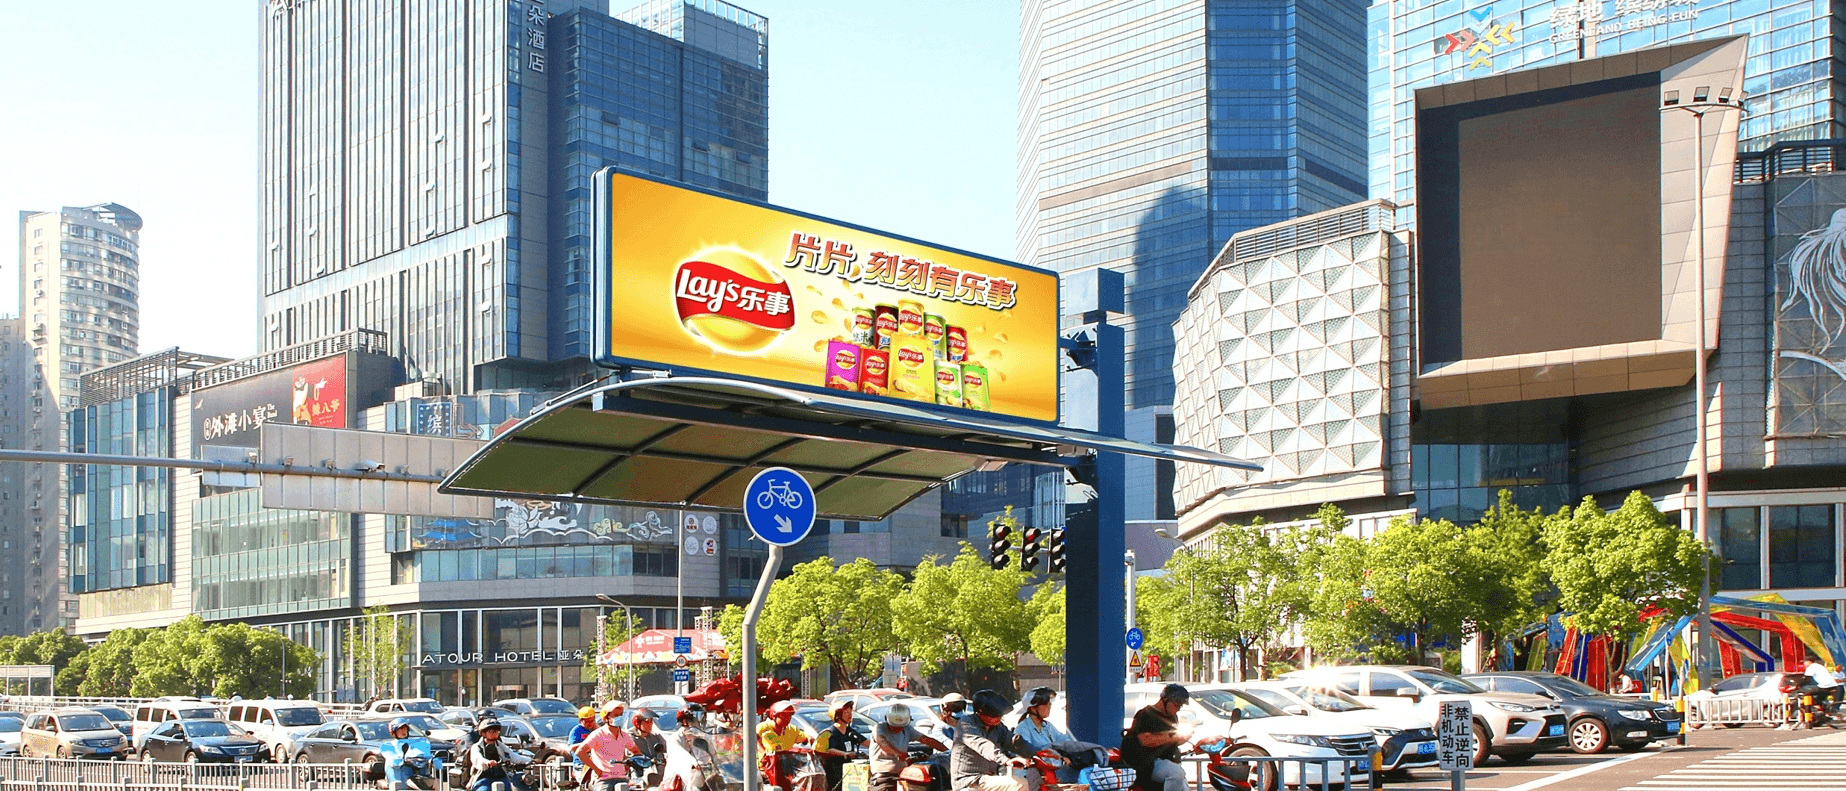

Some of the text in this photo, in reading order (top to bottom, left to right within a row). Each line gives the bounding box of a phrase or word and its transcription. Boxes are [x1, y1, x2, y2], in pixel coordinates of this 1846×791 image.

[1550, 0, 1604, 29] 绿地
[1550, 9, 1699, 43] GREENLAND BEING FUN
[528, 0, 545, 73] 朵酒店
[210, 405, 267, 439] 外滩小宴
[422, 649, 583, 664] ATOUR HOTEL 亚朵
[1441, 703, 1454, 765] 非机动车
[1455, 706, 1470, 768] 禁止逆向
